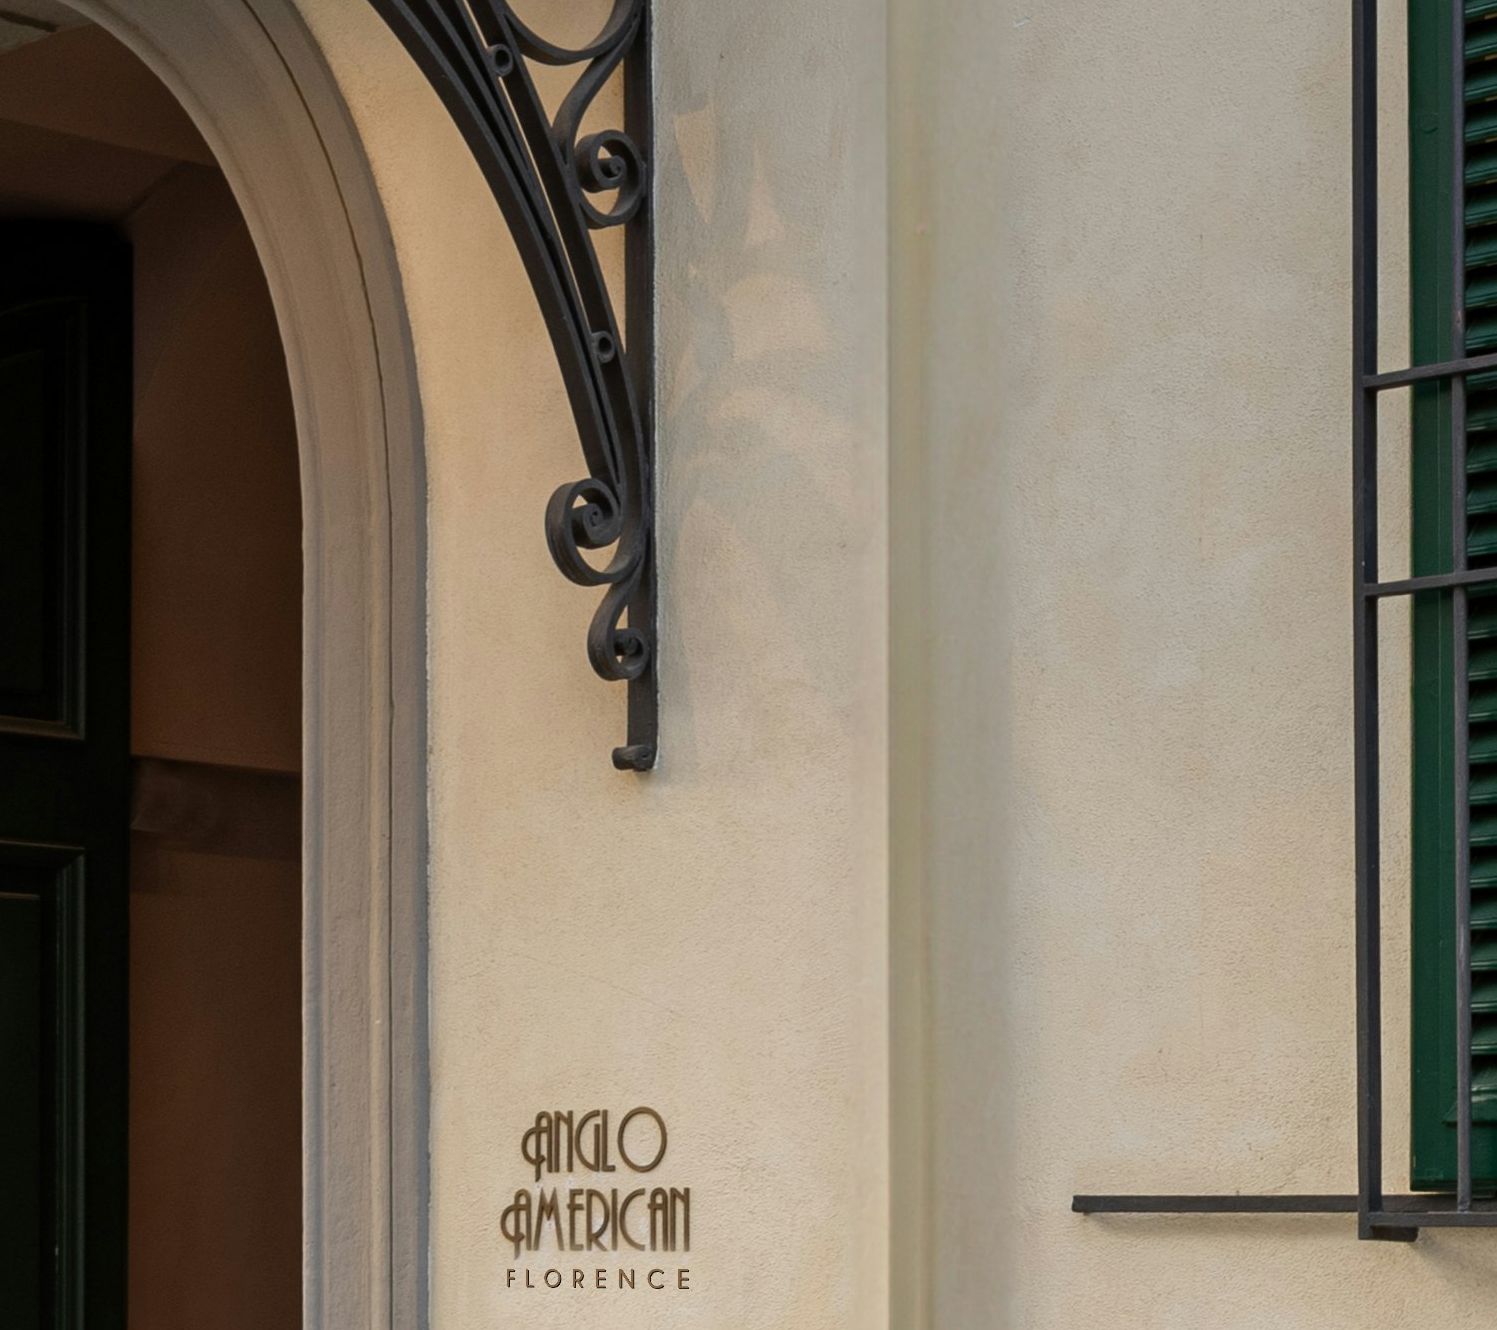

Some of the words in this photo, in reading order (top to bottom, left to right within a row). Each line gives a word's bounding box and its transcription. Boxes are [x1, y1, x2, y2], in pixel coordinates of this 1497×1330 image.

[521, 1106, 667, 1182] ANGLO
[500, 1187, 690, 1260] AMERICAN
[507, 1269, 690, 1289] FLORENCE
